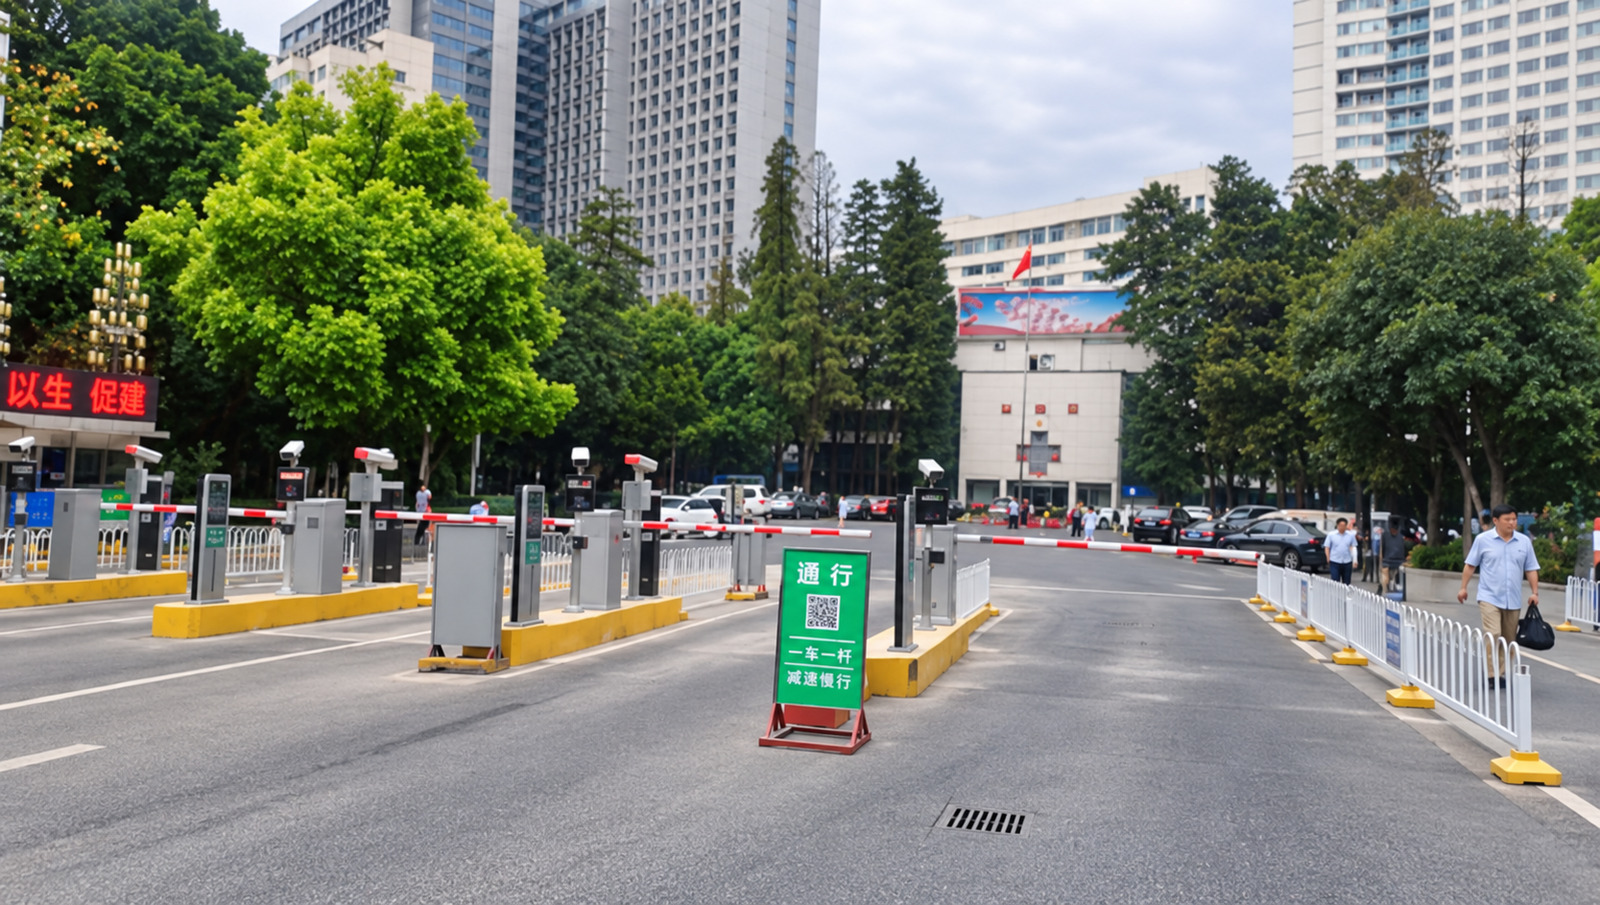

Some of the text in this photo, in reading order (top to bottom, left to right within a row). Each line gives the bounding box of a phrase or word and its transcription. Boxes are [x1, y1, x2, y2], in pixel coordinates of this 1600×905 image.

[7, 370, 147, 417] 以生 促建
[797, 561, 853, 587] 通行
[788, 645, 852, 665] 一车一杆
[786, 670, 852, 690] 减速慢行
